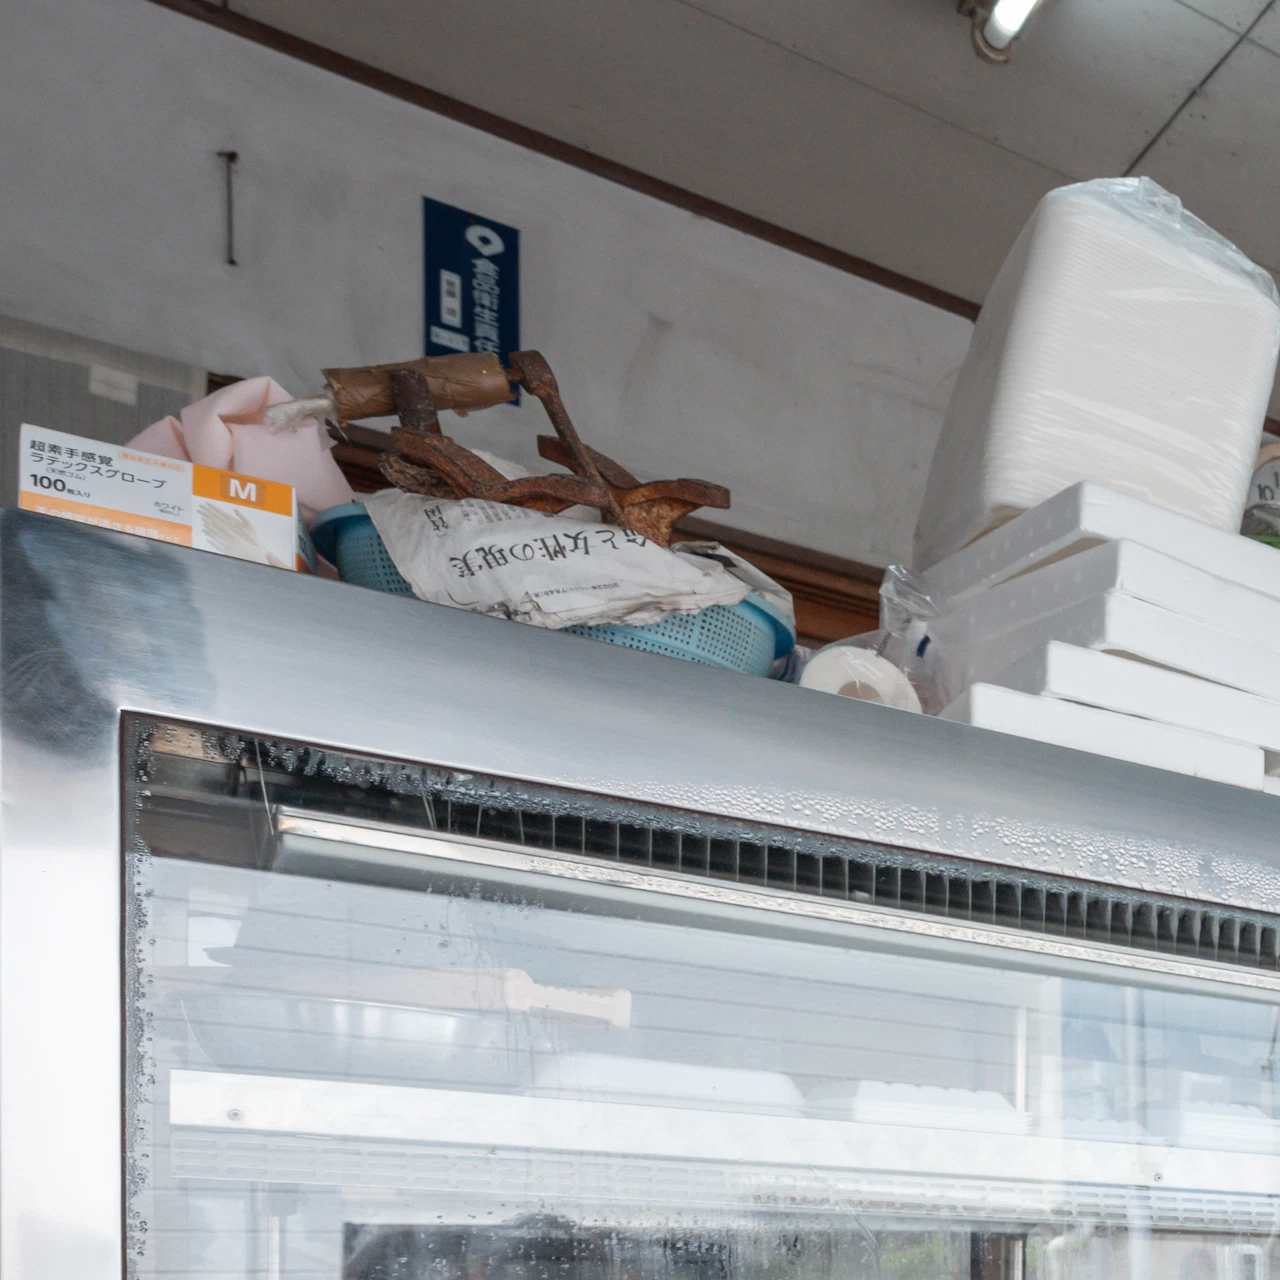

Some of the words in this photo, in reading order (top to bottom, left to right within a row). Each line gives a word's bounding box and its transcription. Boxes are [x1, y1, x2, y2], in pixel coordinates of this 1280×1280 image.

[30, 440, 114, 468] 超素手感覚
[30, 452, 167, 489] ラテックスグローブ
[229, 478, 257, 502] M
[1257, 484, 1274, 502] 10
